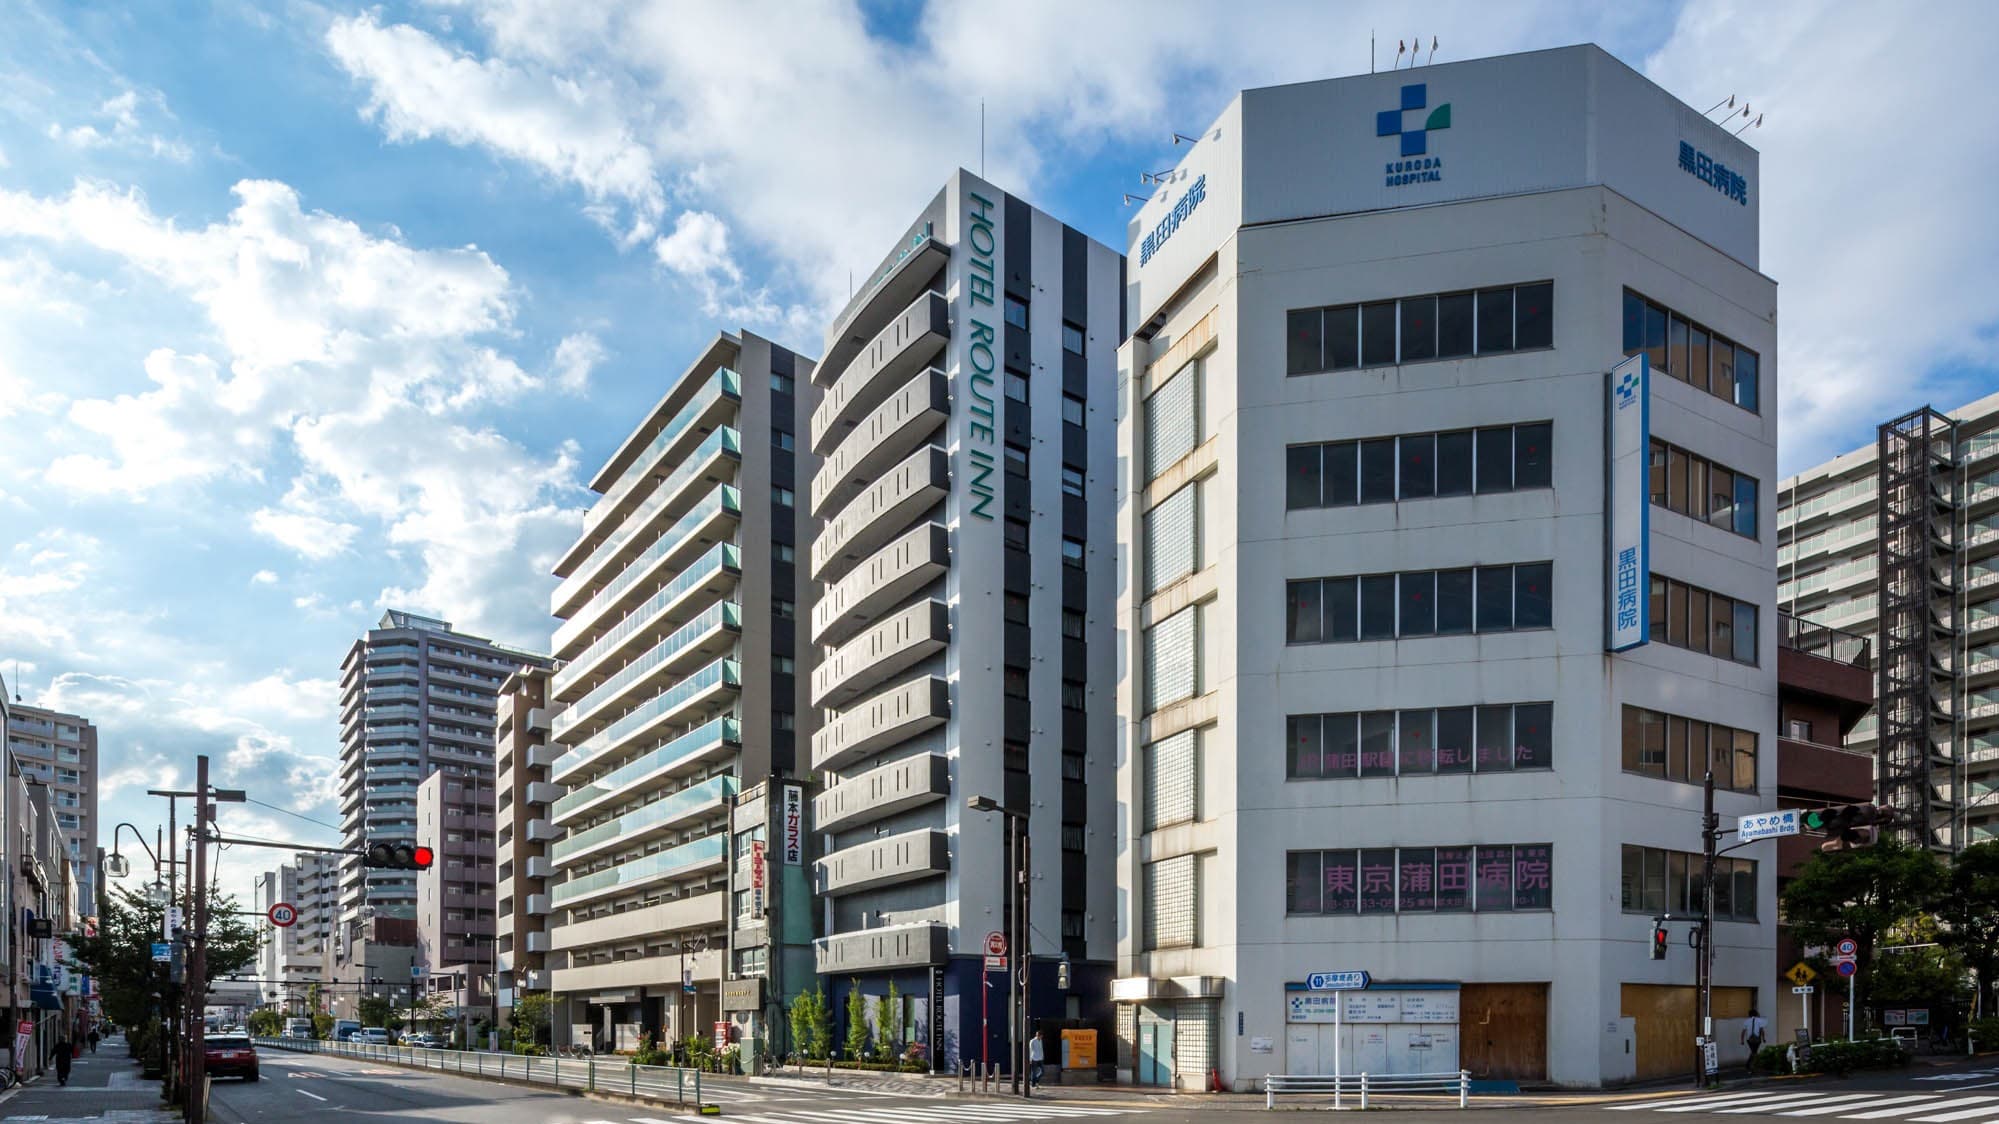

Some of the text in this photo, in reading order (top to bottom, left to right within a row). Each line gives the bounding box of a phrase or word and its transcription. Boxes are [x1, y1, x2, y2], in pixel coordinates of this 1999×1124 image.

[1386, 157, 1441, 174] KURODA
[1386, 170, 1442, 187] HOSPITAL
[1679, 140, 1747, 206] 黒田病院
[1140, 174, 1205, 268] 黒田病院
[970, 192, 995, 522] HOTEL ROUTE INN
[1618, 547, 1637, 632] 黒田病院
[788, 790, 799, 862] 藤本ガラス店
[1744, 813, 1793, 829] あやめ橋
[1325, 860, 1549, 894] 東京蒲田病院
[275, 909, 291, 921] 40
[1842, 943, 1853, 952] 40
